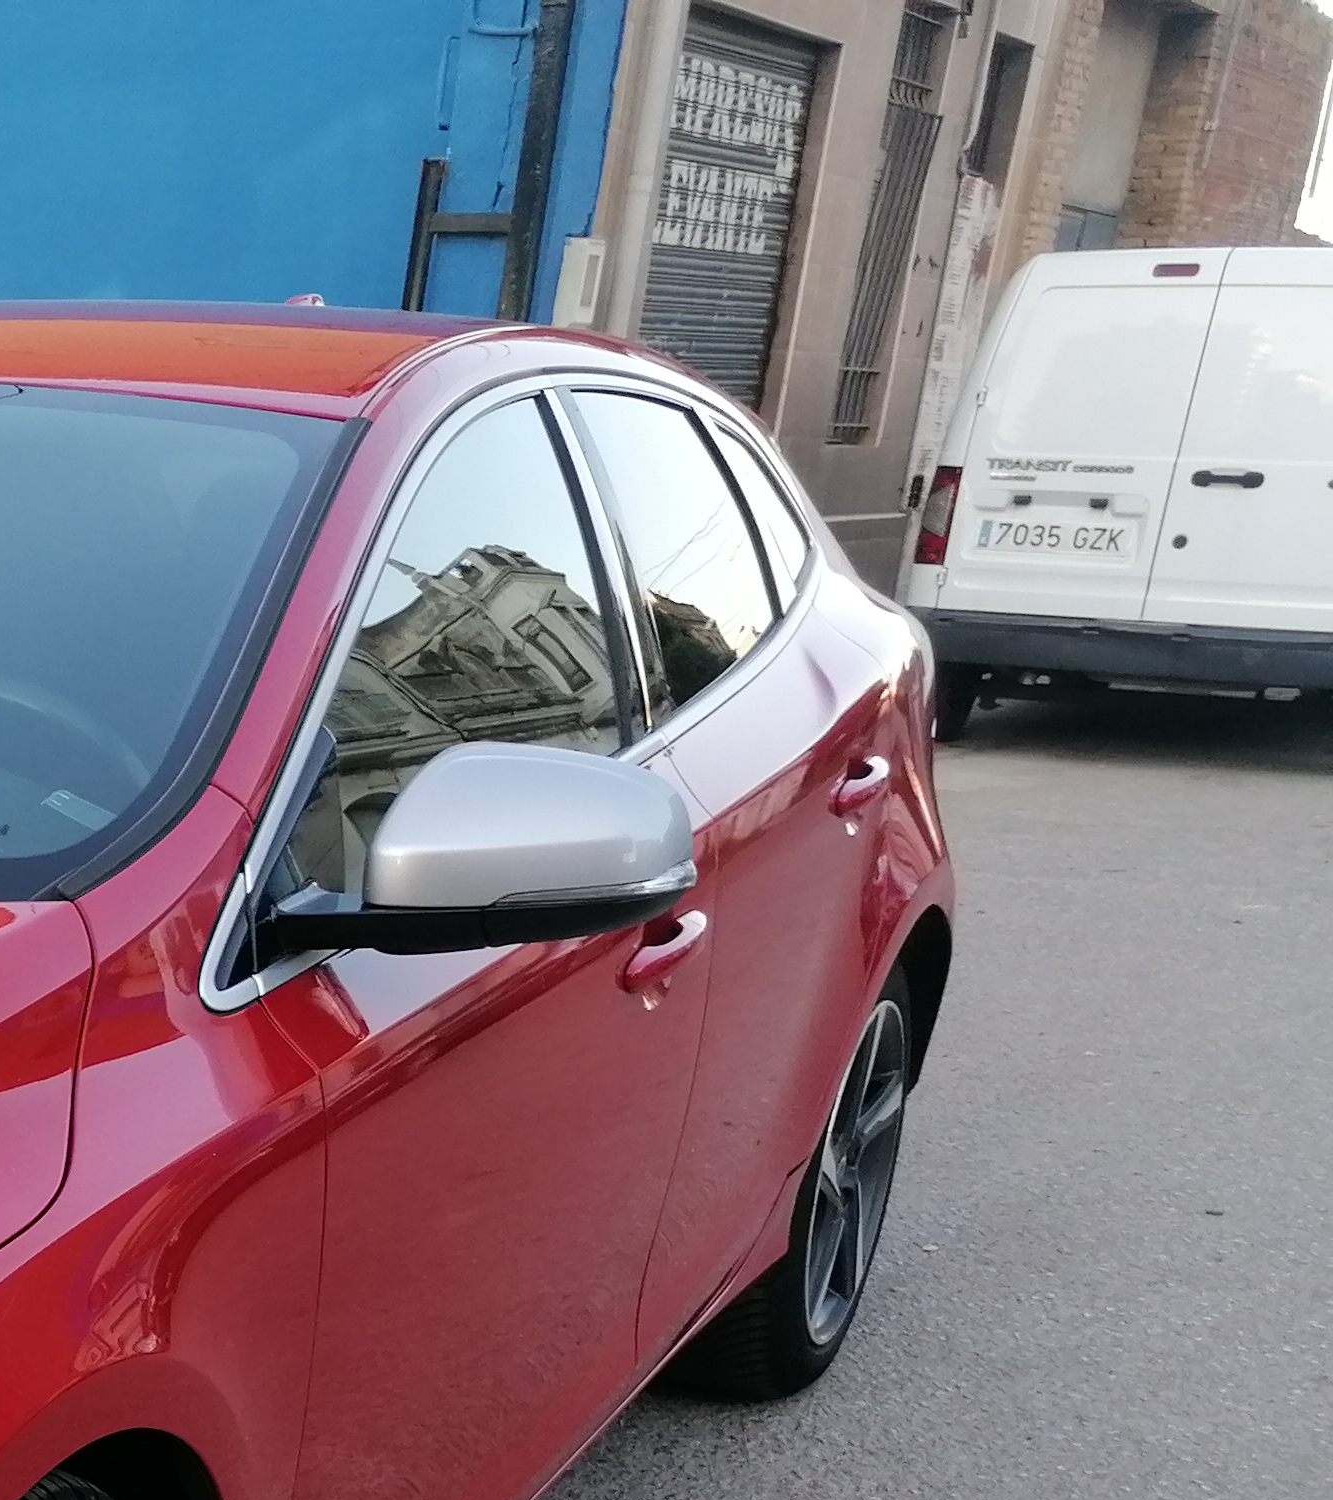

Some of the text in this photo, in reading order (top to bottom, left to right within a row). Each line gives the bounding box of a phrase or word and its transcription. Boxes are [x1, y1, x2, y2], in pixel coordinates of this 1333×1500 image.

[652, 157, 775, 255] EVANTE
[986, 457, 1072, 473] TRANSIT
[995, 522, 1062, 548] 7035
[1073, 526, 1125, 552] GZK
